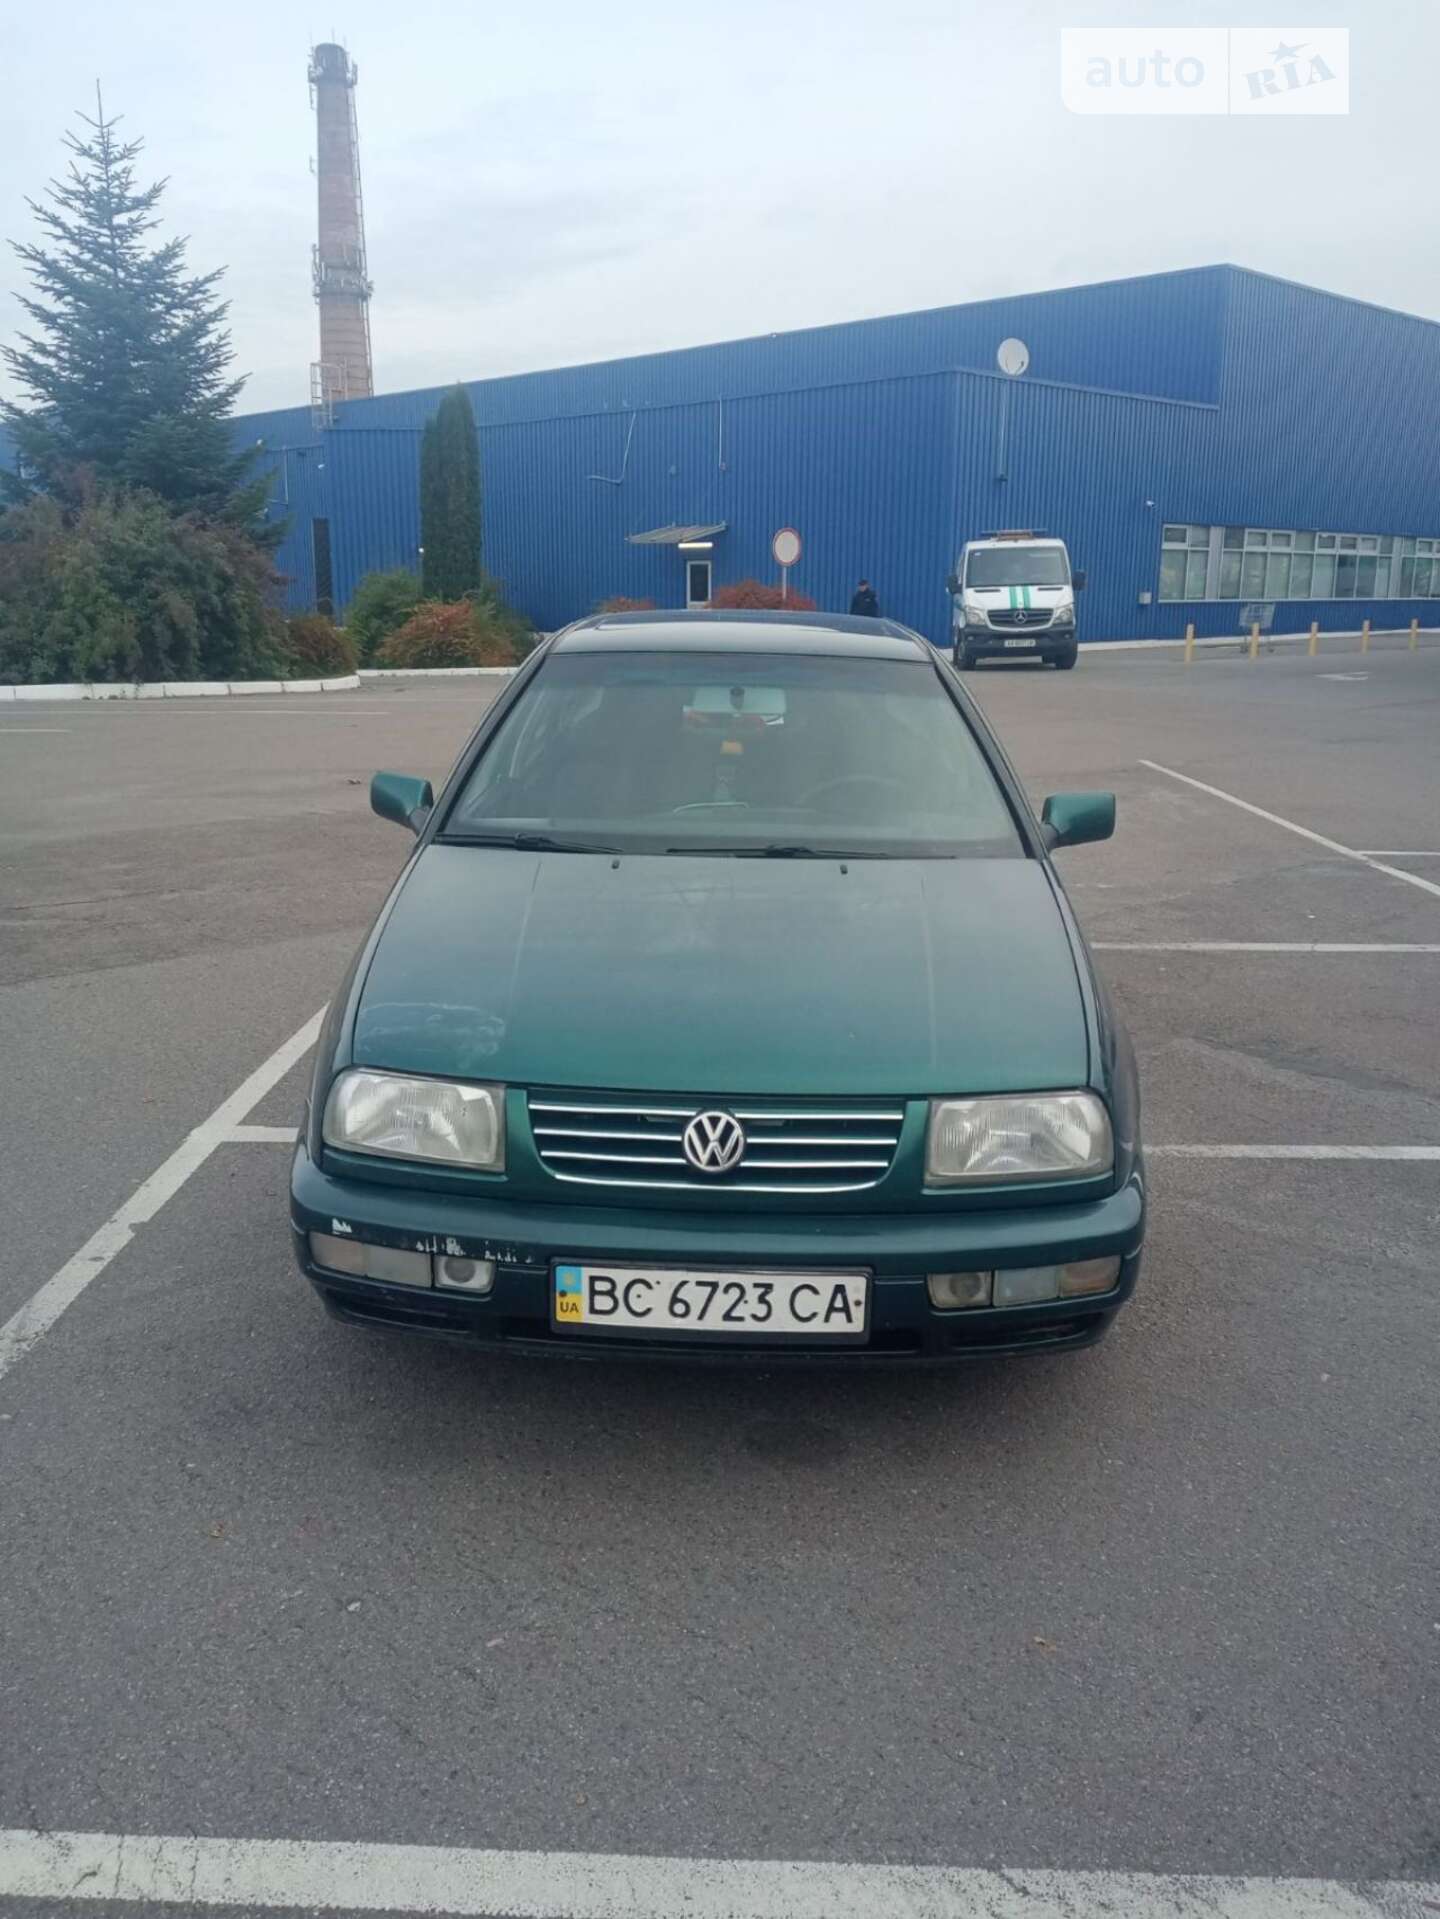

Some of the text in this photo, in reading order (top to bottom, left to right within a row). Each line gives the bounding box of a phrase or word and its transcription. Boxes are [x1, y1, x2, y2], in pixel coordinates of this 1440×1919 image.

[559, 1302, 579, 1314] UA
[588, 1276, 853, 1323] BC 6723 CA
